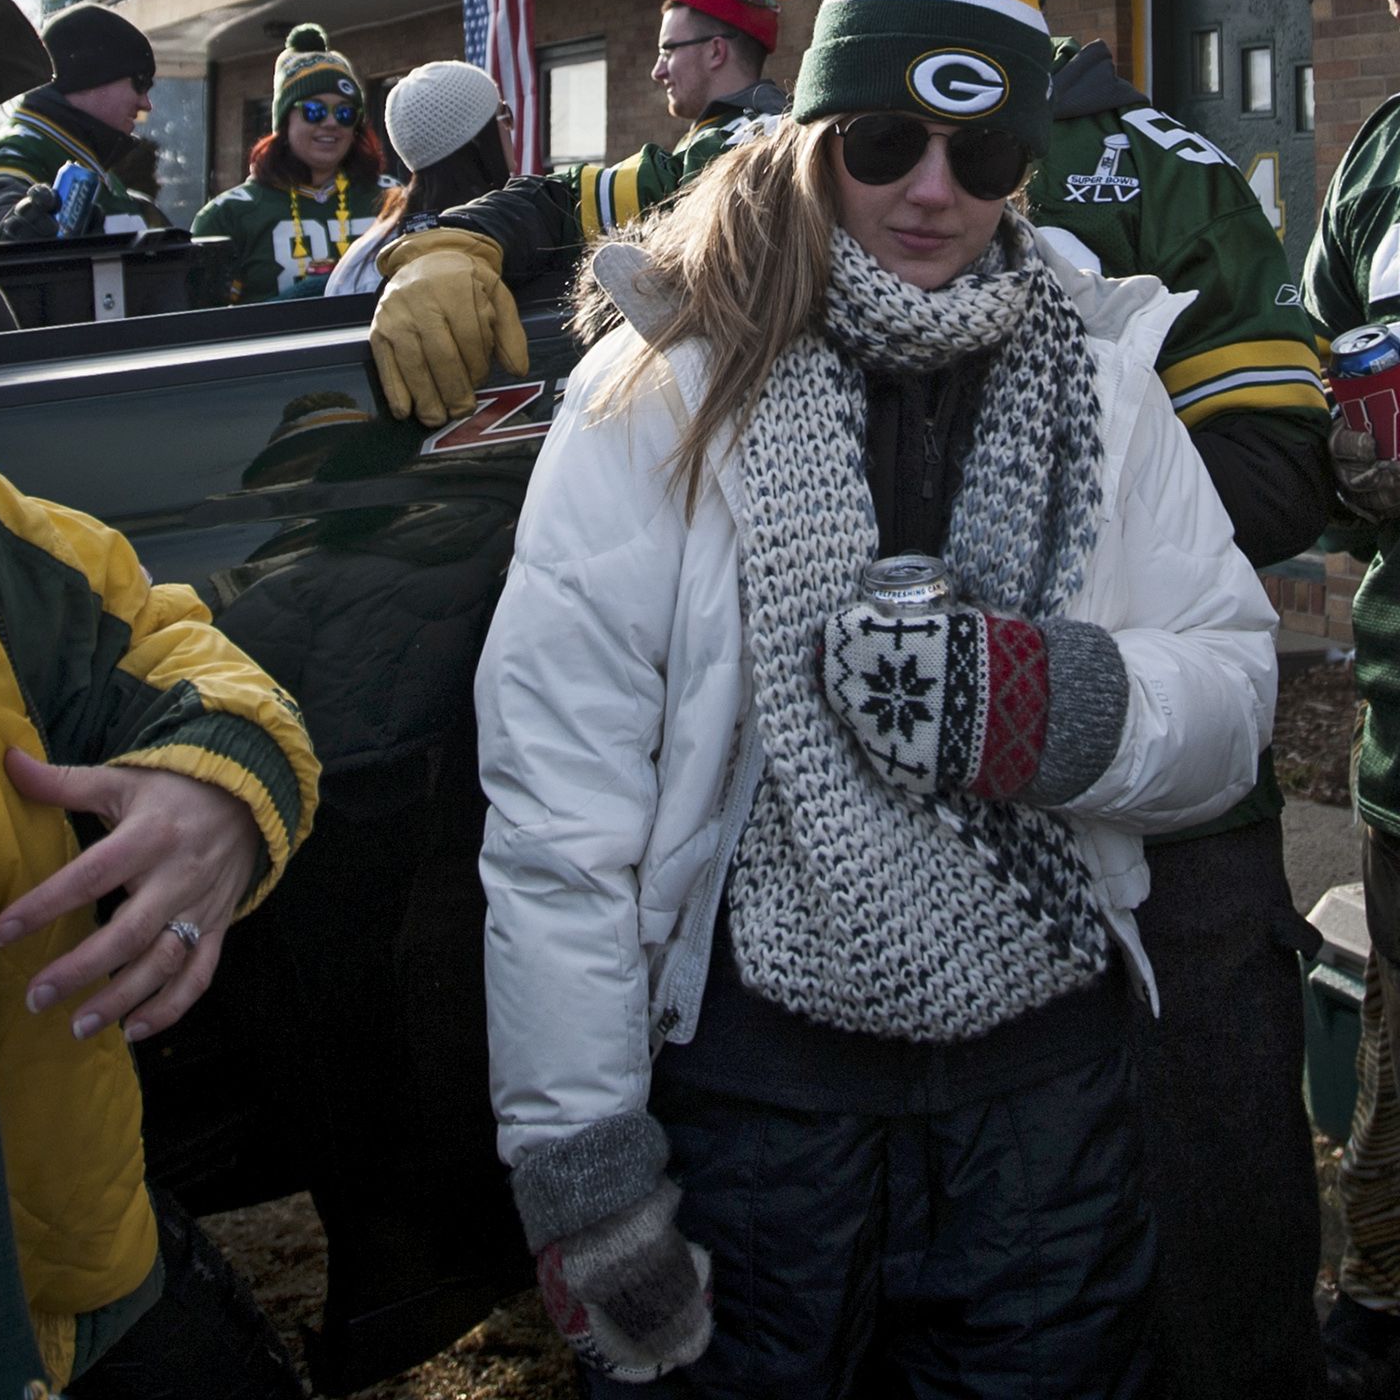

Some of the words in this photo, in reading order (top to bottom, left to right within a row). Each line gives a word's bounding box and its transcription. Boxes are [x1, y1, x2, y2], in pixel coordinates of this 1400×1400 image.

[913, 54, 1004, 114] G
[1071, 175, 1103, 186] SUPER
[1105, 175, 1137, 187] BOWL
[1064, 183, 1141, 203] XLV
[928, 583, 941, 594] CAN
